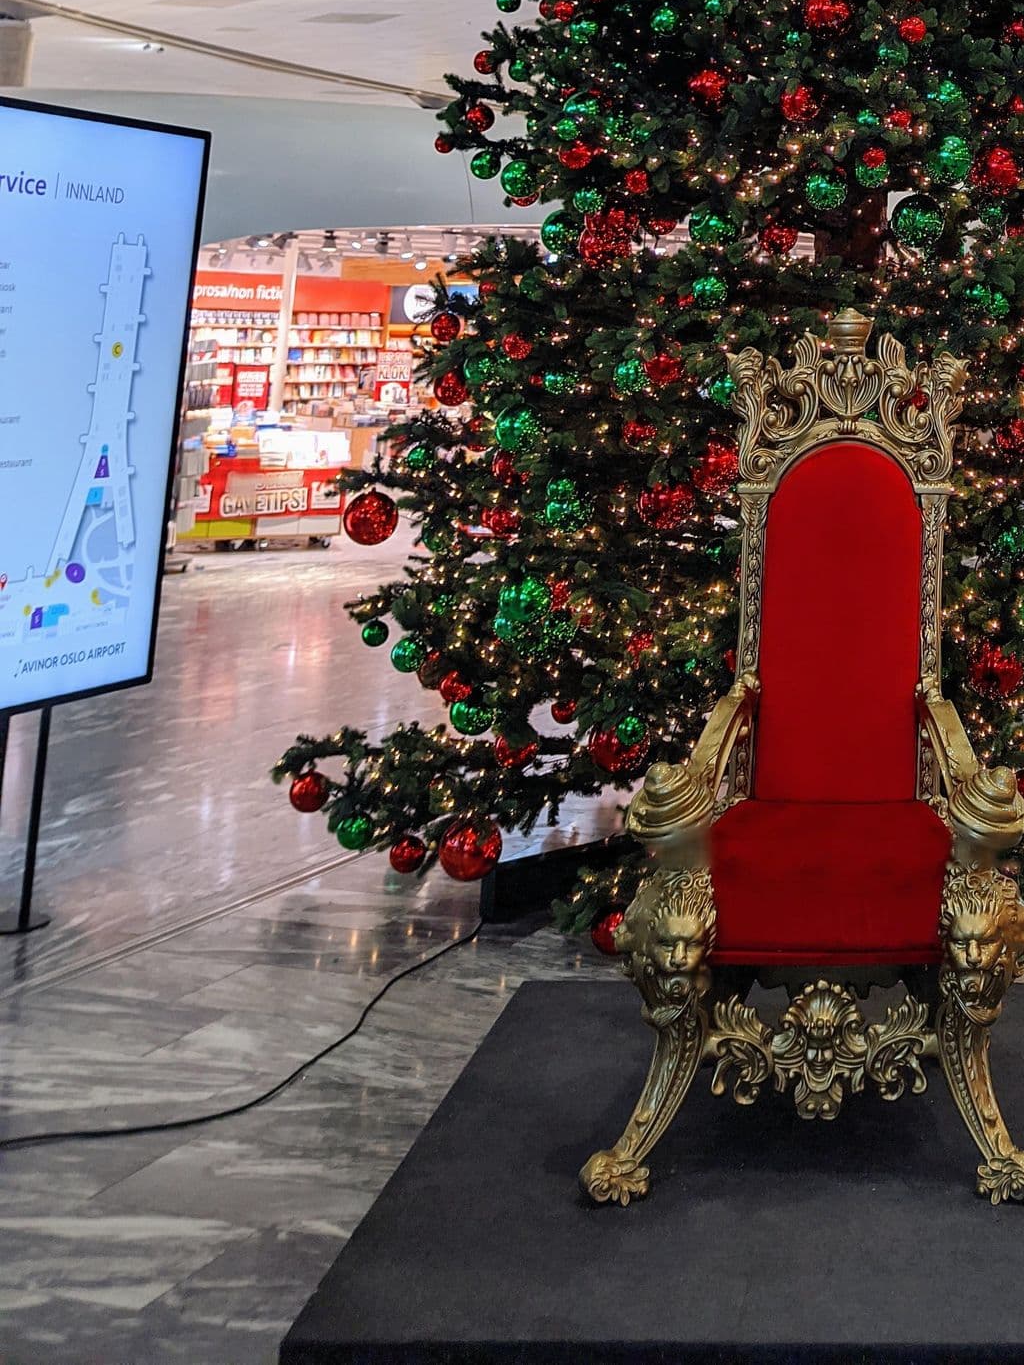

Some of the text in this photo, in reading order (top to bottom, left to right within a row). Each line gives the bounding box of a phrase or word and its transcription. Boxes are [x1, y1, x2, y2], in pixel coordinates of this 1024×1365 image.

[66, 182, 125, 204] INNLAND
[223, 488, 306, 514] GAETIPS!
[21, 642, 126, 674] AVINOR OSLO AIRPORT
